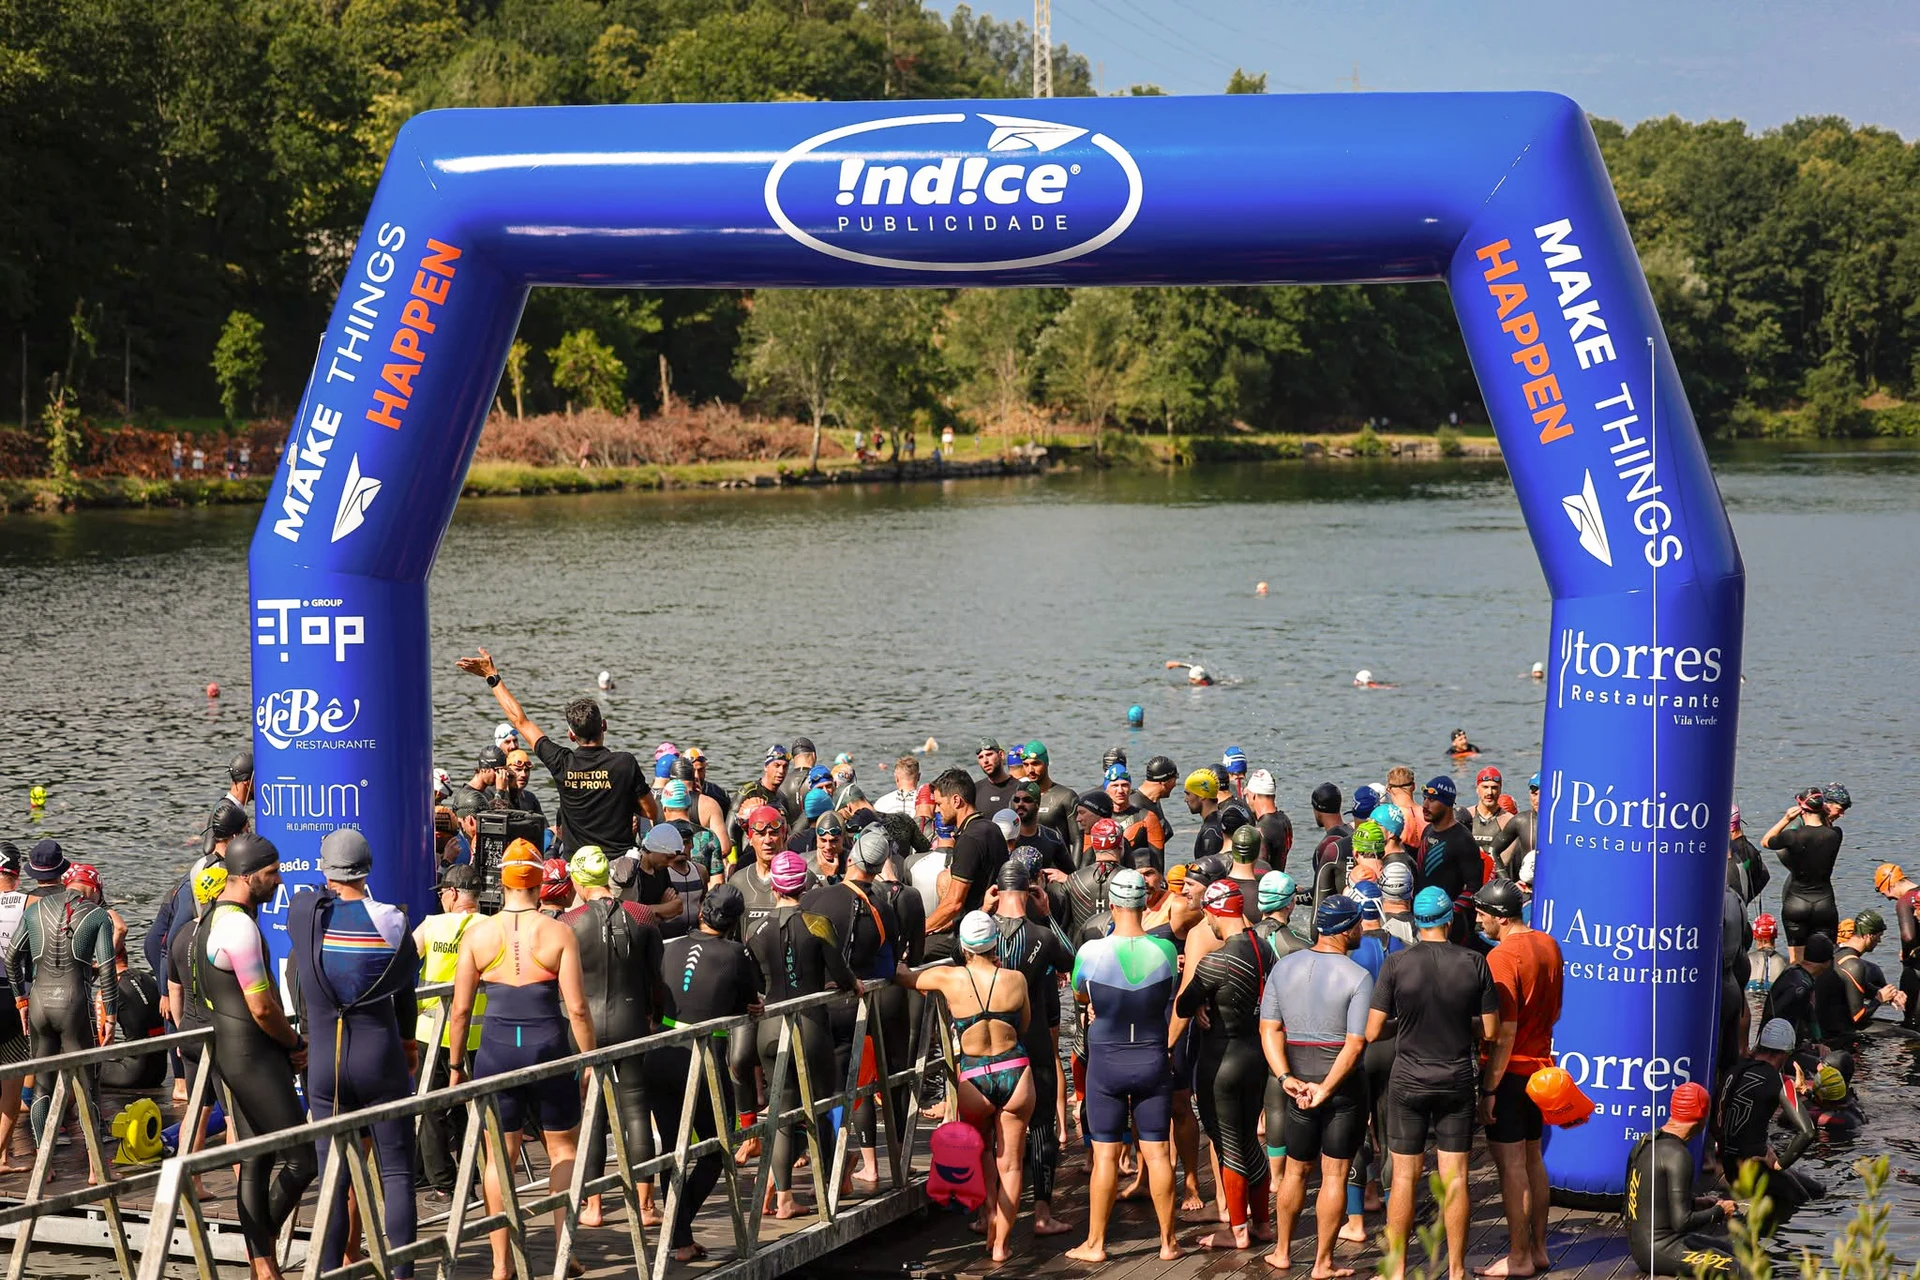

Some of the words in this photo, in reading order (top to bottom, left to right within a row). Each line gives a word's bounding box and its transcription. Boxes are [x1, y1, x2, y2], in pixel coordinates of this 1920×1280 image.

[837, 215, 1068, 232] PUBLICIDADE
[365, 237, 462, 430] HAPPEN
[1475, 238, 1575, 445] HAPPEN
[273, 403, 342, 543] MAKE
[326, 222, 406, 383] THINGS
[1534, 218, 1617, 370] MAKE
[1594, 382, 1683, 568] THINGS
[311, 599, 343, 607] GROUP
[1573, 630, 1722, 683] torres
[1571, 685, 1719, 708] Restaurante
[1673, 714, 1693, 725] Vila
[1695, 715, 1717, 725] Verde
[296, 739, 376, 749] RESTAURANTE
[565, 780, 578, 788] DE
[580, 780, 612, 789] PROVA
[567, 771, 609, 780] DIRETOR
[1568, 780, 1709, 830] Pórtico
[286, 822, 334, 831] ALOJAMENTO
[1565, 832, 1707, 854] restaurante
[279, 858, 310, 873] esde
[1562, 908, 1699, 960] Augusta
[433, 941, 458, 953] ORGAN
[1027, 940, 1042, 964] 2XU
